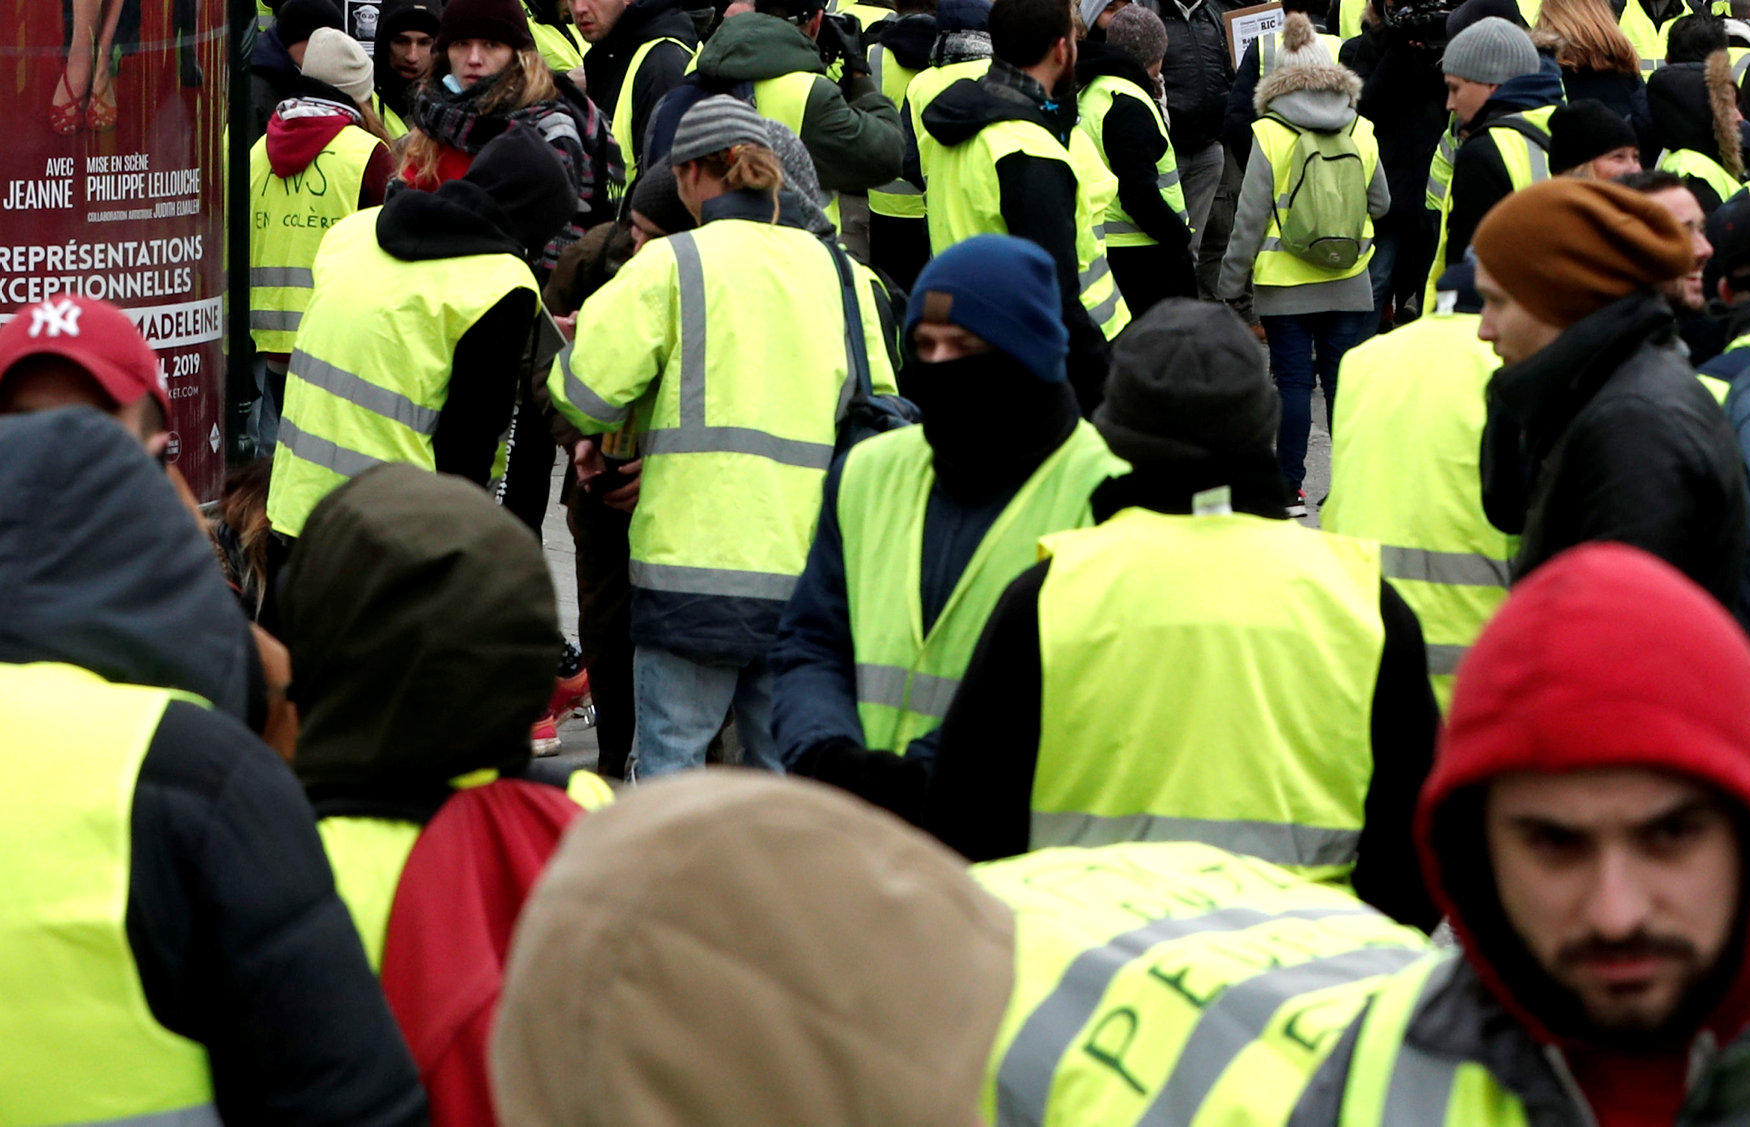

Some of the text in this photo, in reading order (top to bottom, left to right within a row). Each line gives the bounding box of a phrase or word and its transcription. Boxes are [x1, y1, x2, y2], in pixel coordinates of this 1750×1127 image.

[1261, 20, 1276, 31] RIC
[46, 157, 74, 176] AVEC
[86, 152, 149, 173] MISE EN SCÈNE
[3, 179, 73, 210] JEANNE
[87, 168, 200, 201] PHILIPPE LELLOUCHE
[153, 201, 175, 219] JUDITH
[255, 212, 271, 229] EN
[0, 235, 203, 272] REPRÉSENTATIONS
[172, 353, 200, 377] 2019
